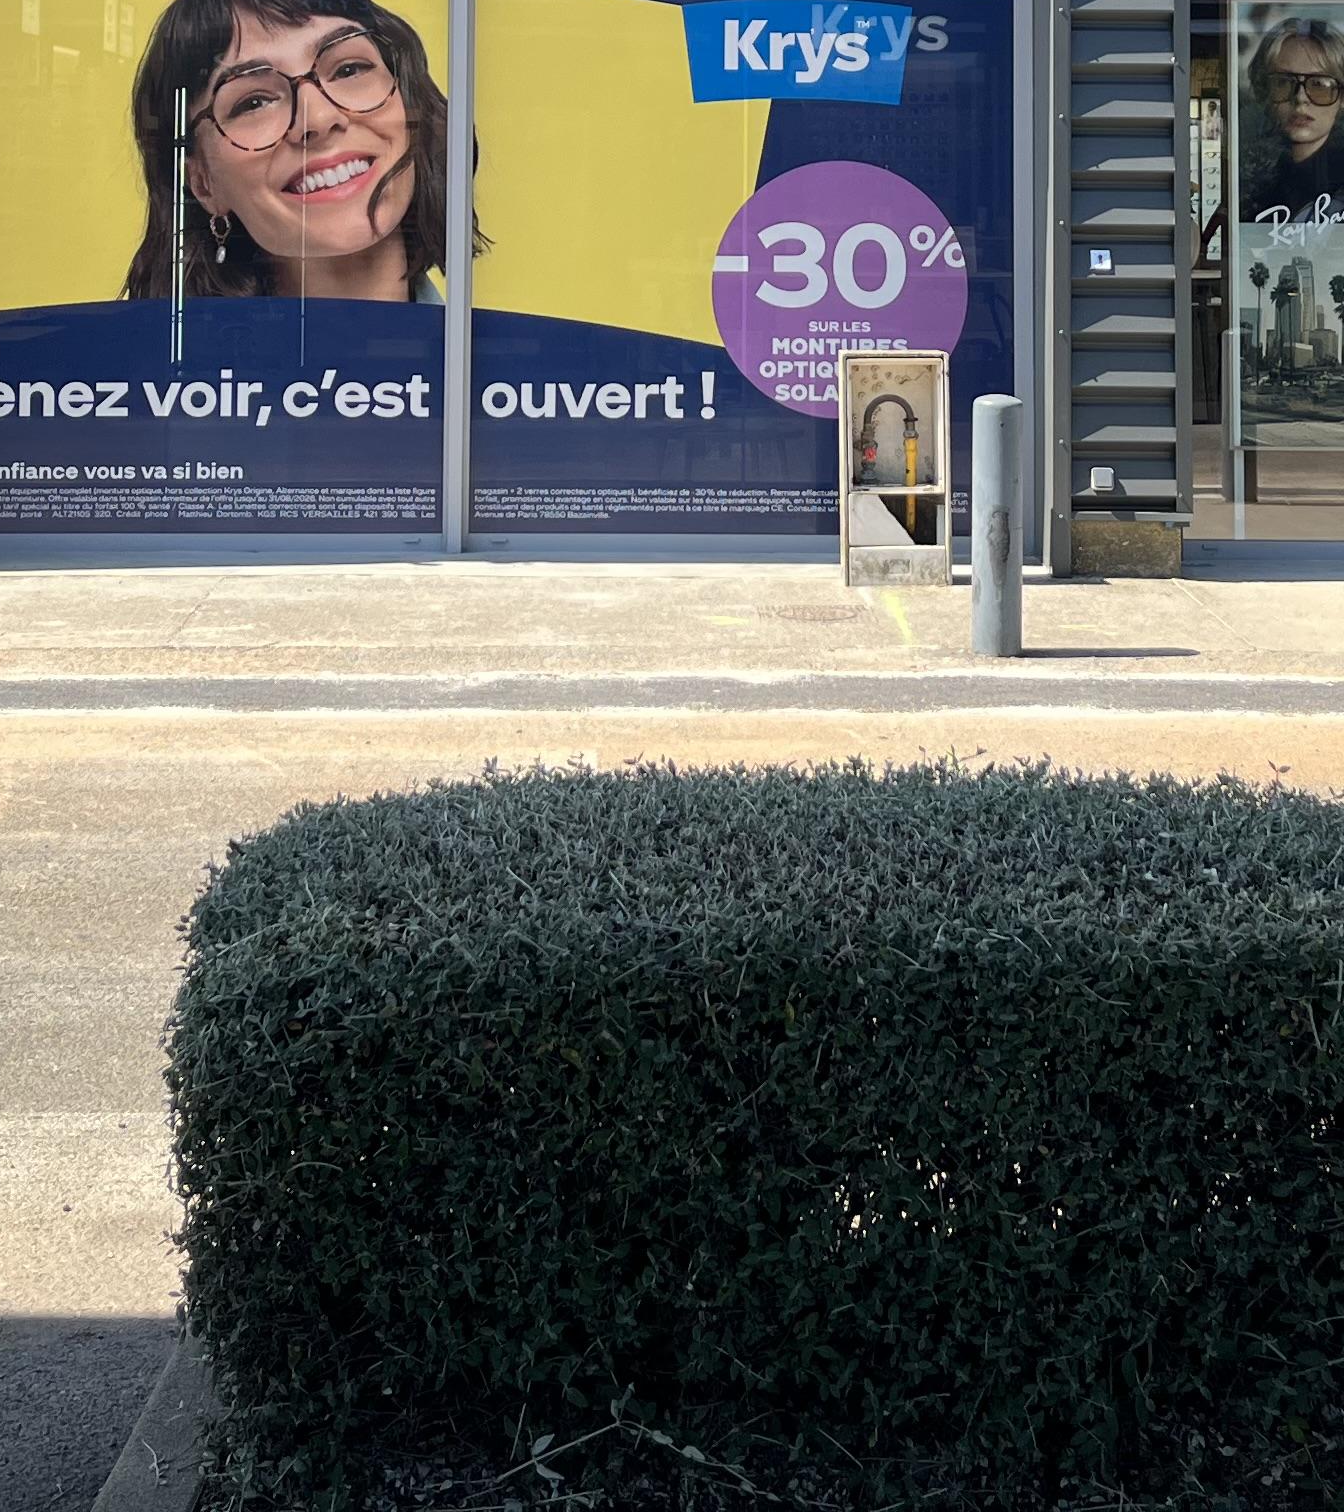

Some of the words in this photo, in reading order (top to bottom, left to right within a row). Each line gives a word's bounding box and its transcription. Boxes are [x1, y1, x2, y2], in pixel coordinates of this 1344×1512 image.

[724, 20, 870, 83] Krys
[712, 222, 966, 309] -30%
[808, 321, 840, 333] SUR
[842, 321, 871, 333] LES
[759, 360, 839, 378] OPTIQ
[143, 369, 272, 427] voir,
[283, 369, 430, 418] c'est
[482, 377, 684, 419] ouvert
[700, 371, 716, 420] !
[84, 466, 136, 480] vous
[141, 466, 167, 480] va
[173, 462, 191, 480] si
[196, 462, 244, 480] bien
[224, 487, 242, 496] Krys
